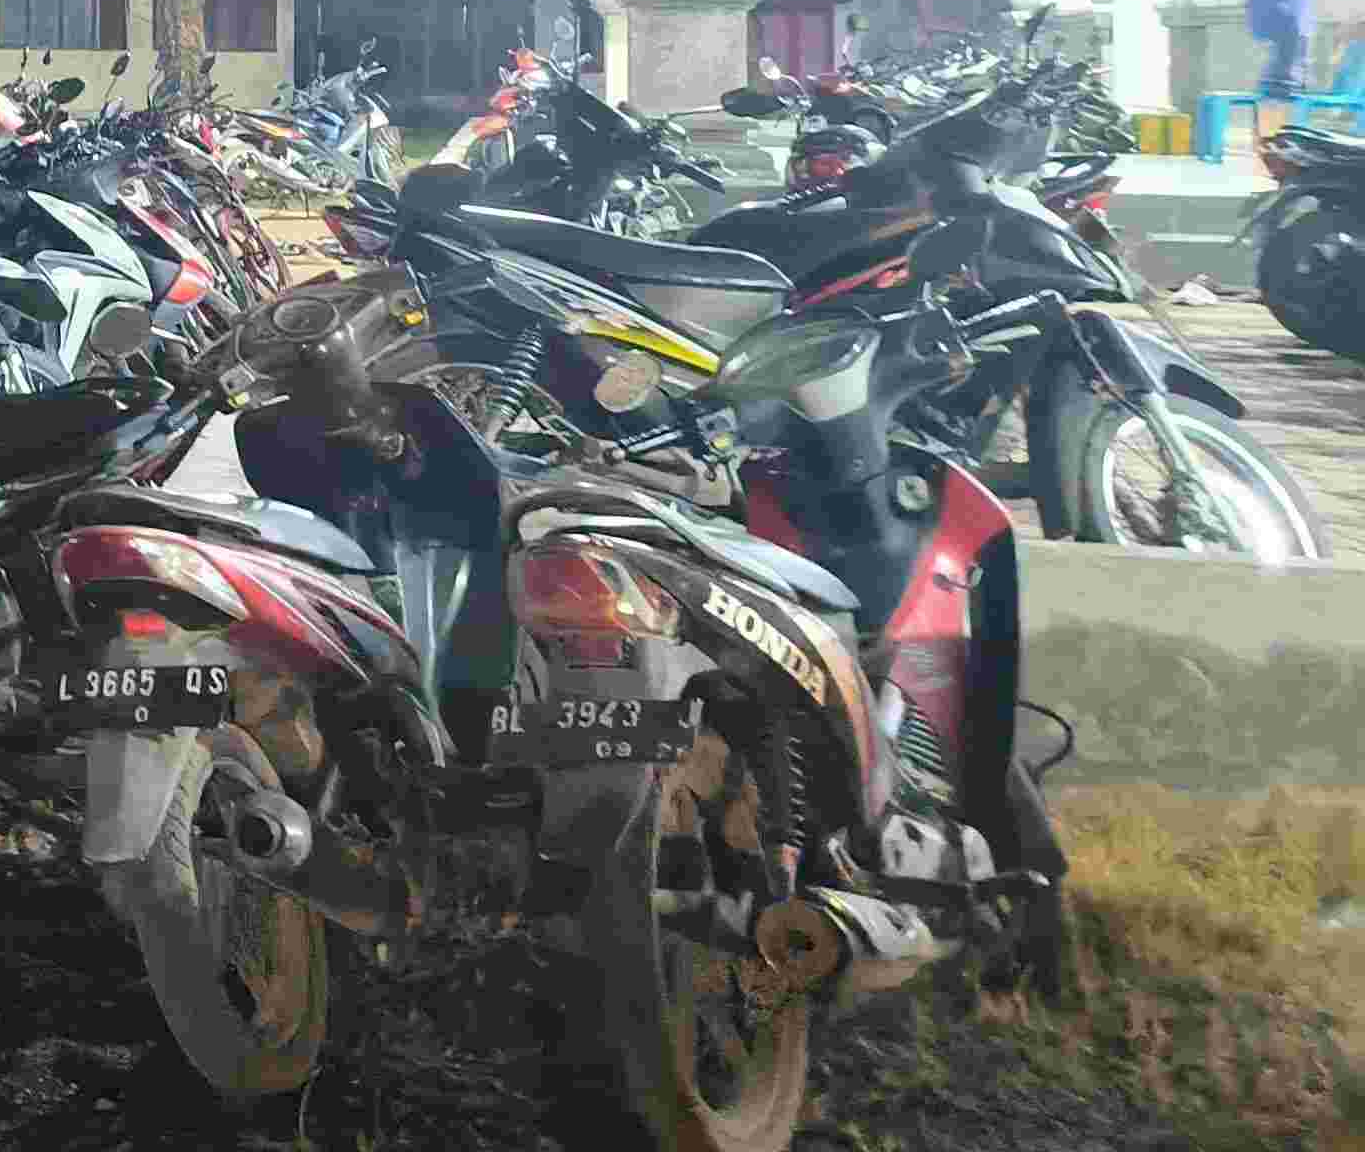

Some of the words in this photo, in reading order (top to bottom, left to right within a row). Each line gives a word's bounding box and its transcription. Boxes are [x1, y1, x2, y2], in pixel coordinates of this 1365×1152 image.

[703, 582, 826, 706] HONDA
[59, 673, 73, 701] L
[85, 668, 156, 697] 3665
[491, 704, 525, 734] BL
